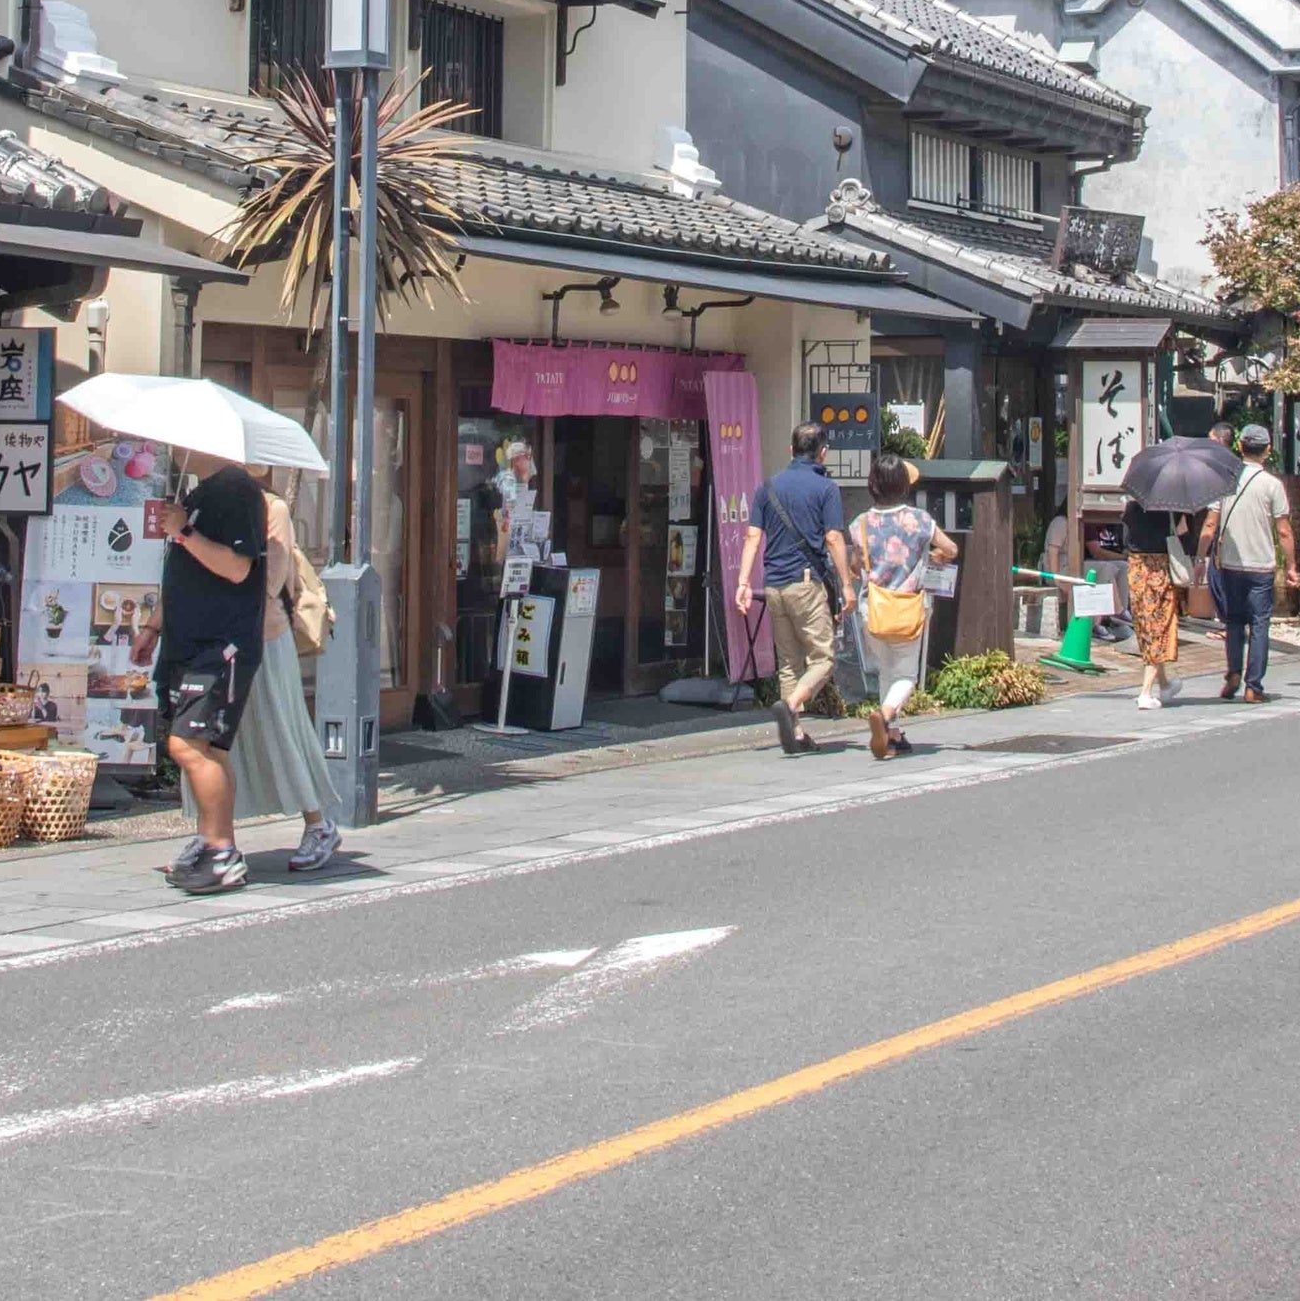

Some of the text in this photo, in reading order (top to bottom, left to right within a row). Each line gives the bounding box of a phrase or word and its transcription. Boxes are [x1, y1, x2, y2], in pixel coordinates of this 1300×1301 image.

[1096, 369, 1135, 475] そば
[515, 603, 536, 667] ごみ箱
